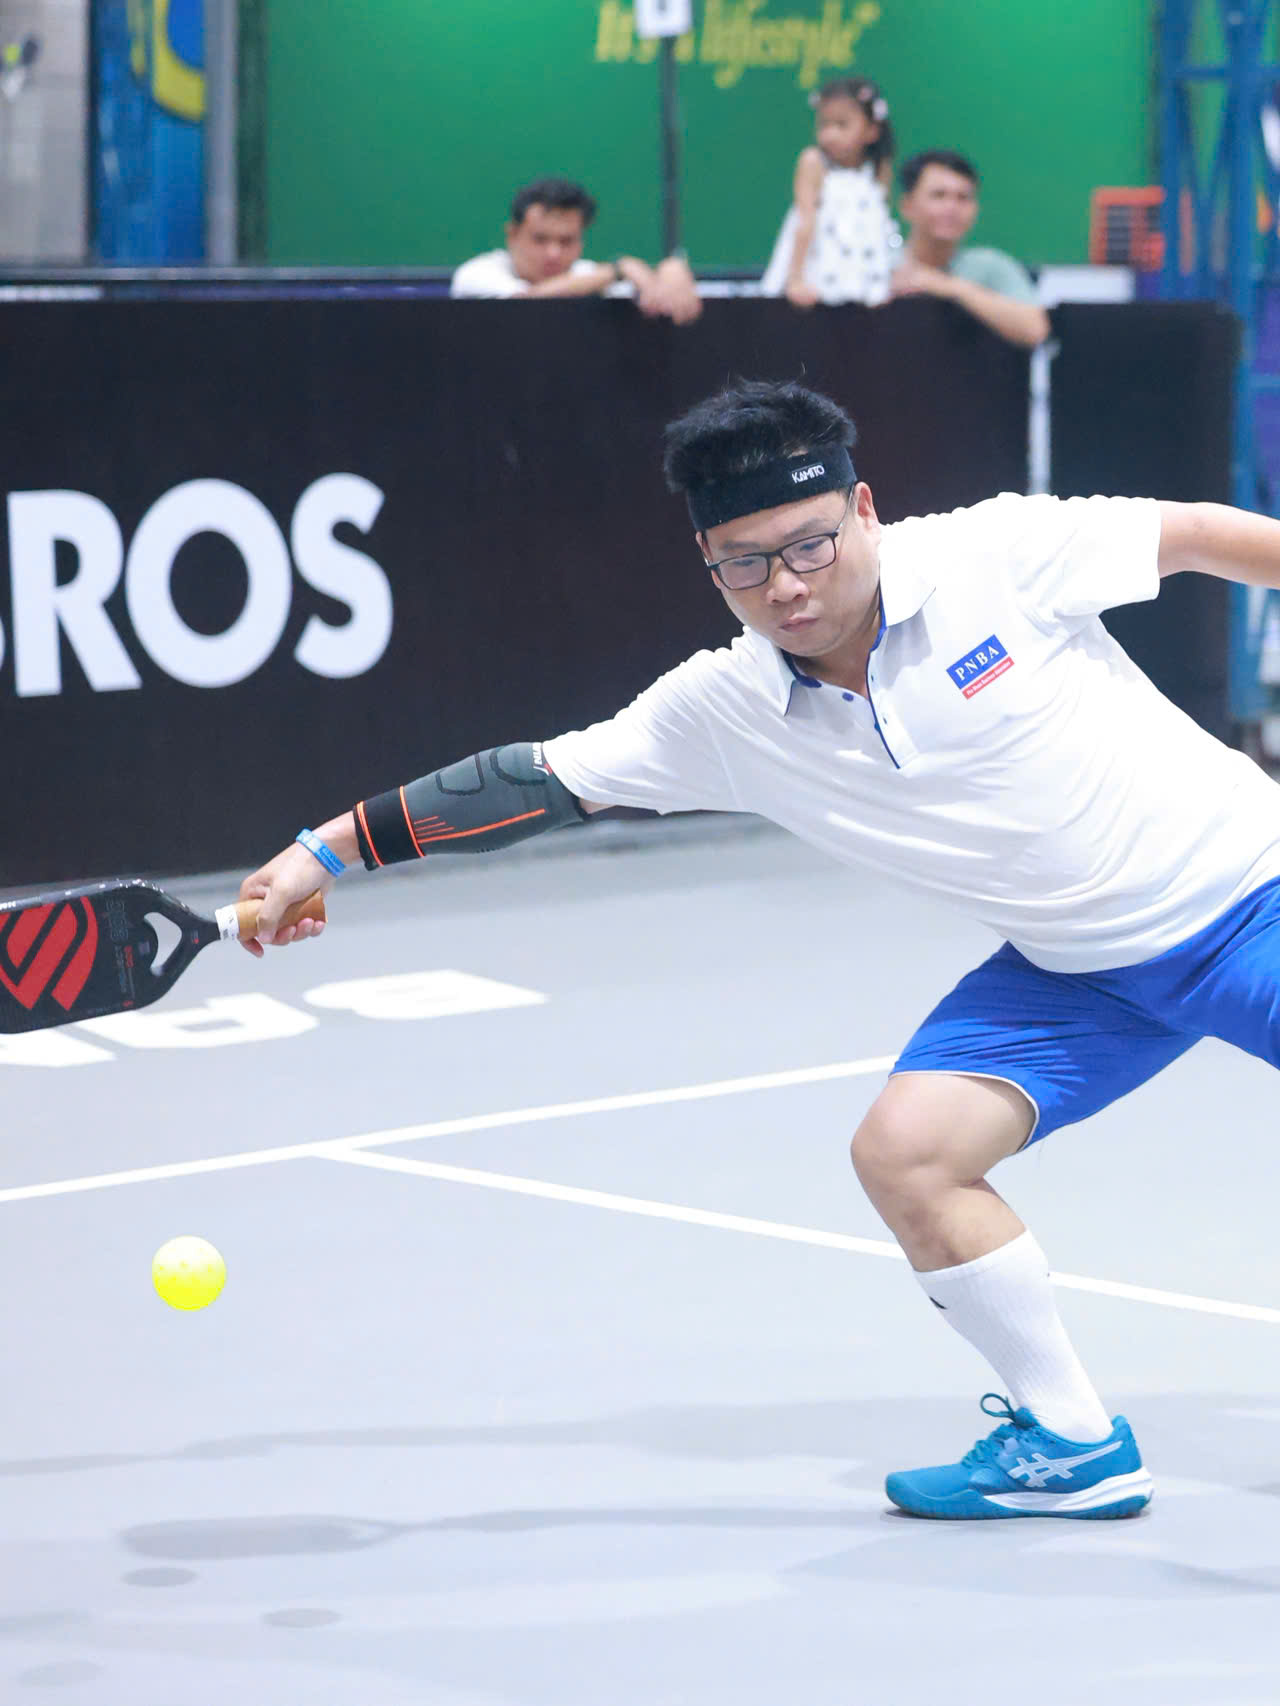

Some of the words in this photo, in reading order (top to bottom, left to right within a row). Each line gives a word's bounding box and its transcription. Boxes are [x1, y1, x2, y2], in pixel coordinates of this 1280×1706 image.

[791, 465, 825, 484] KAMITO
[0, 472, 393, 698] ROS
[954, 645, 1000, 681] PNBA
